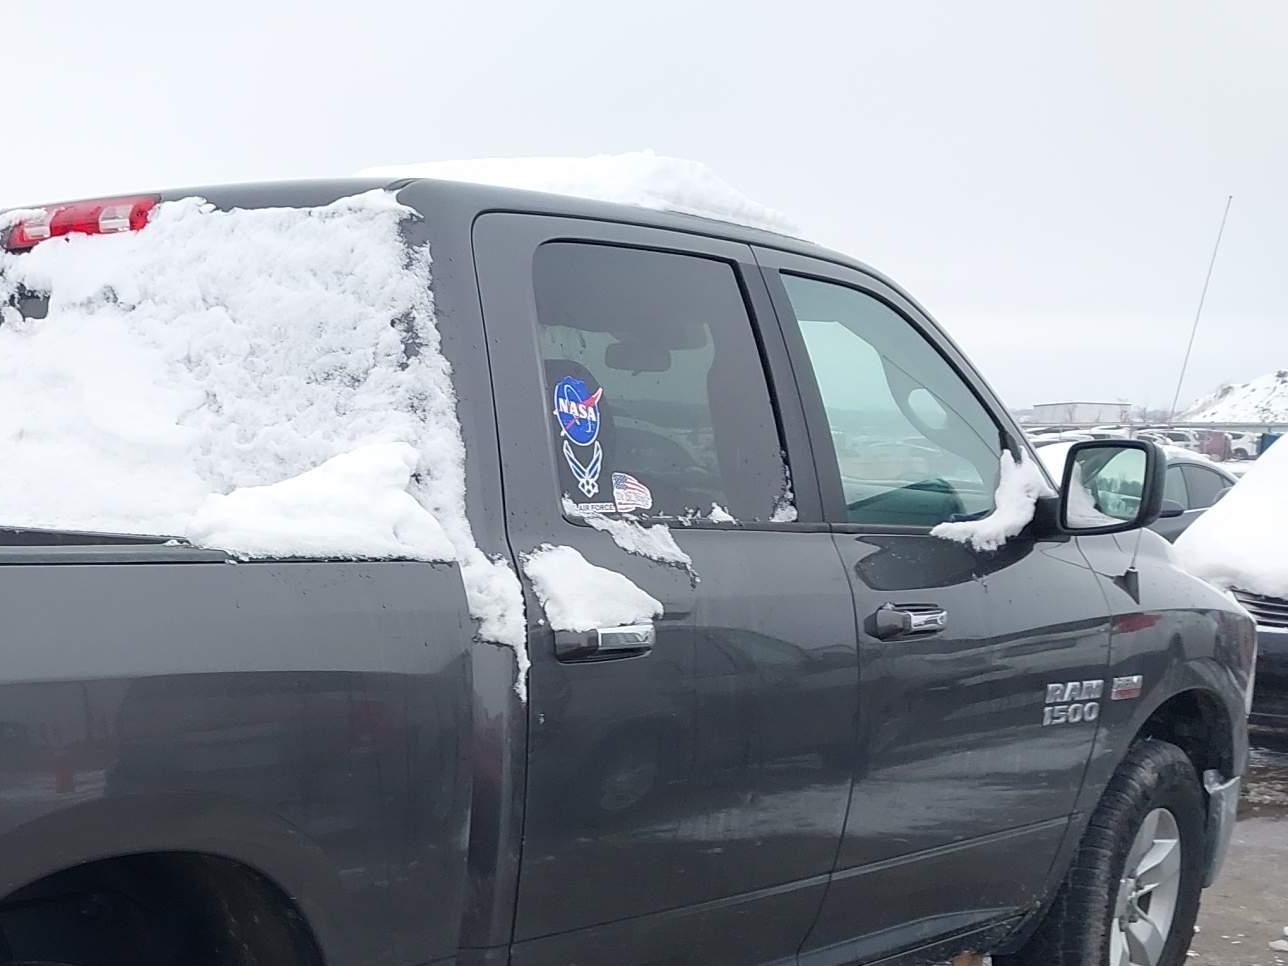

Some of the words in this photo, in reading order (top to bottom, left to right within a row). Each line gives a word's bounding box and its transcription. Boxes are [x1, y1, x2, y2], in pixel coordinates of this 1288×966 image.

[559, 398, 596, 422] NASA
[590, 503, 614, 511] FORCE
[1045, 680, 1105, 704] RAM
[1042, 702, 1100, 726] 1500
